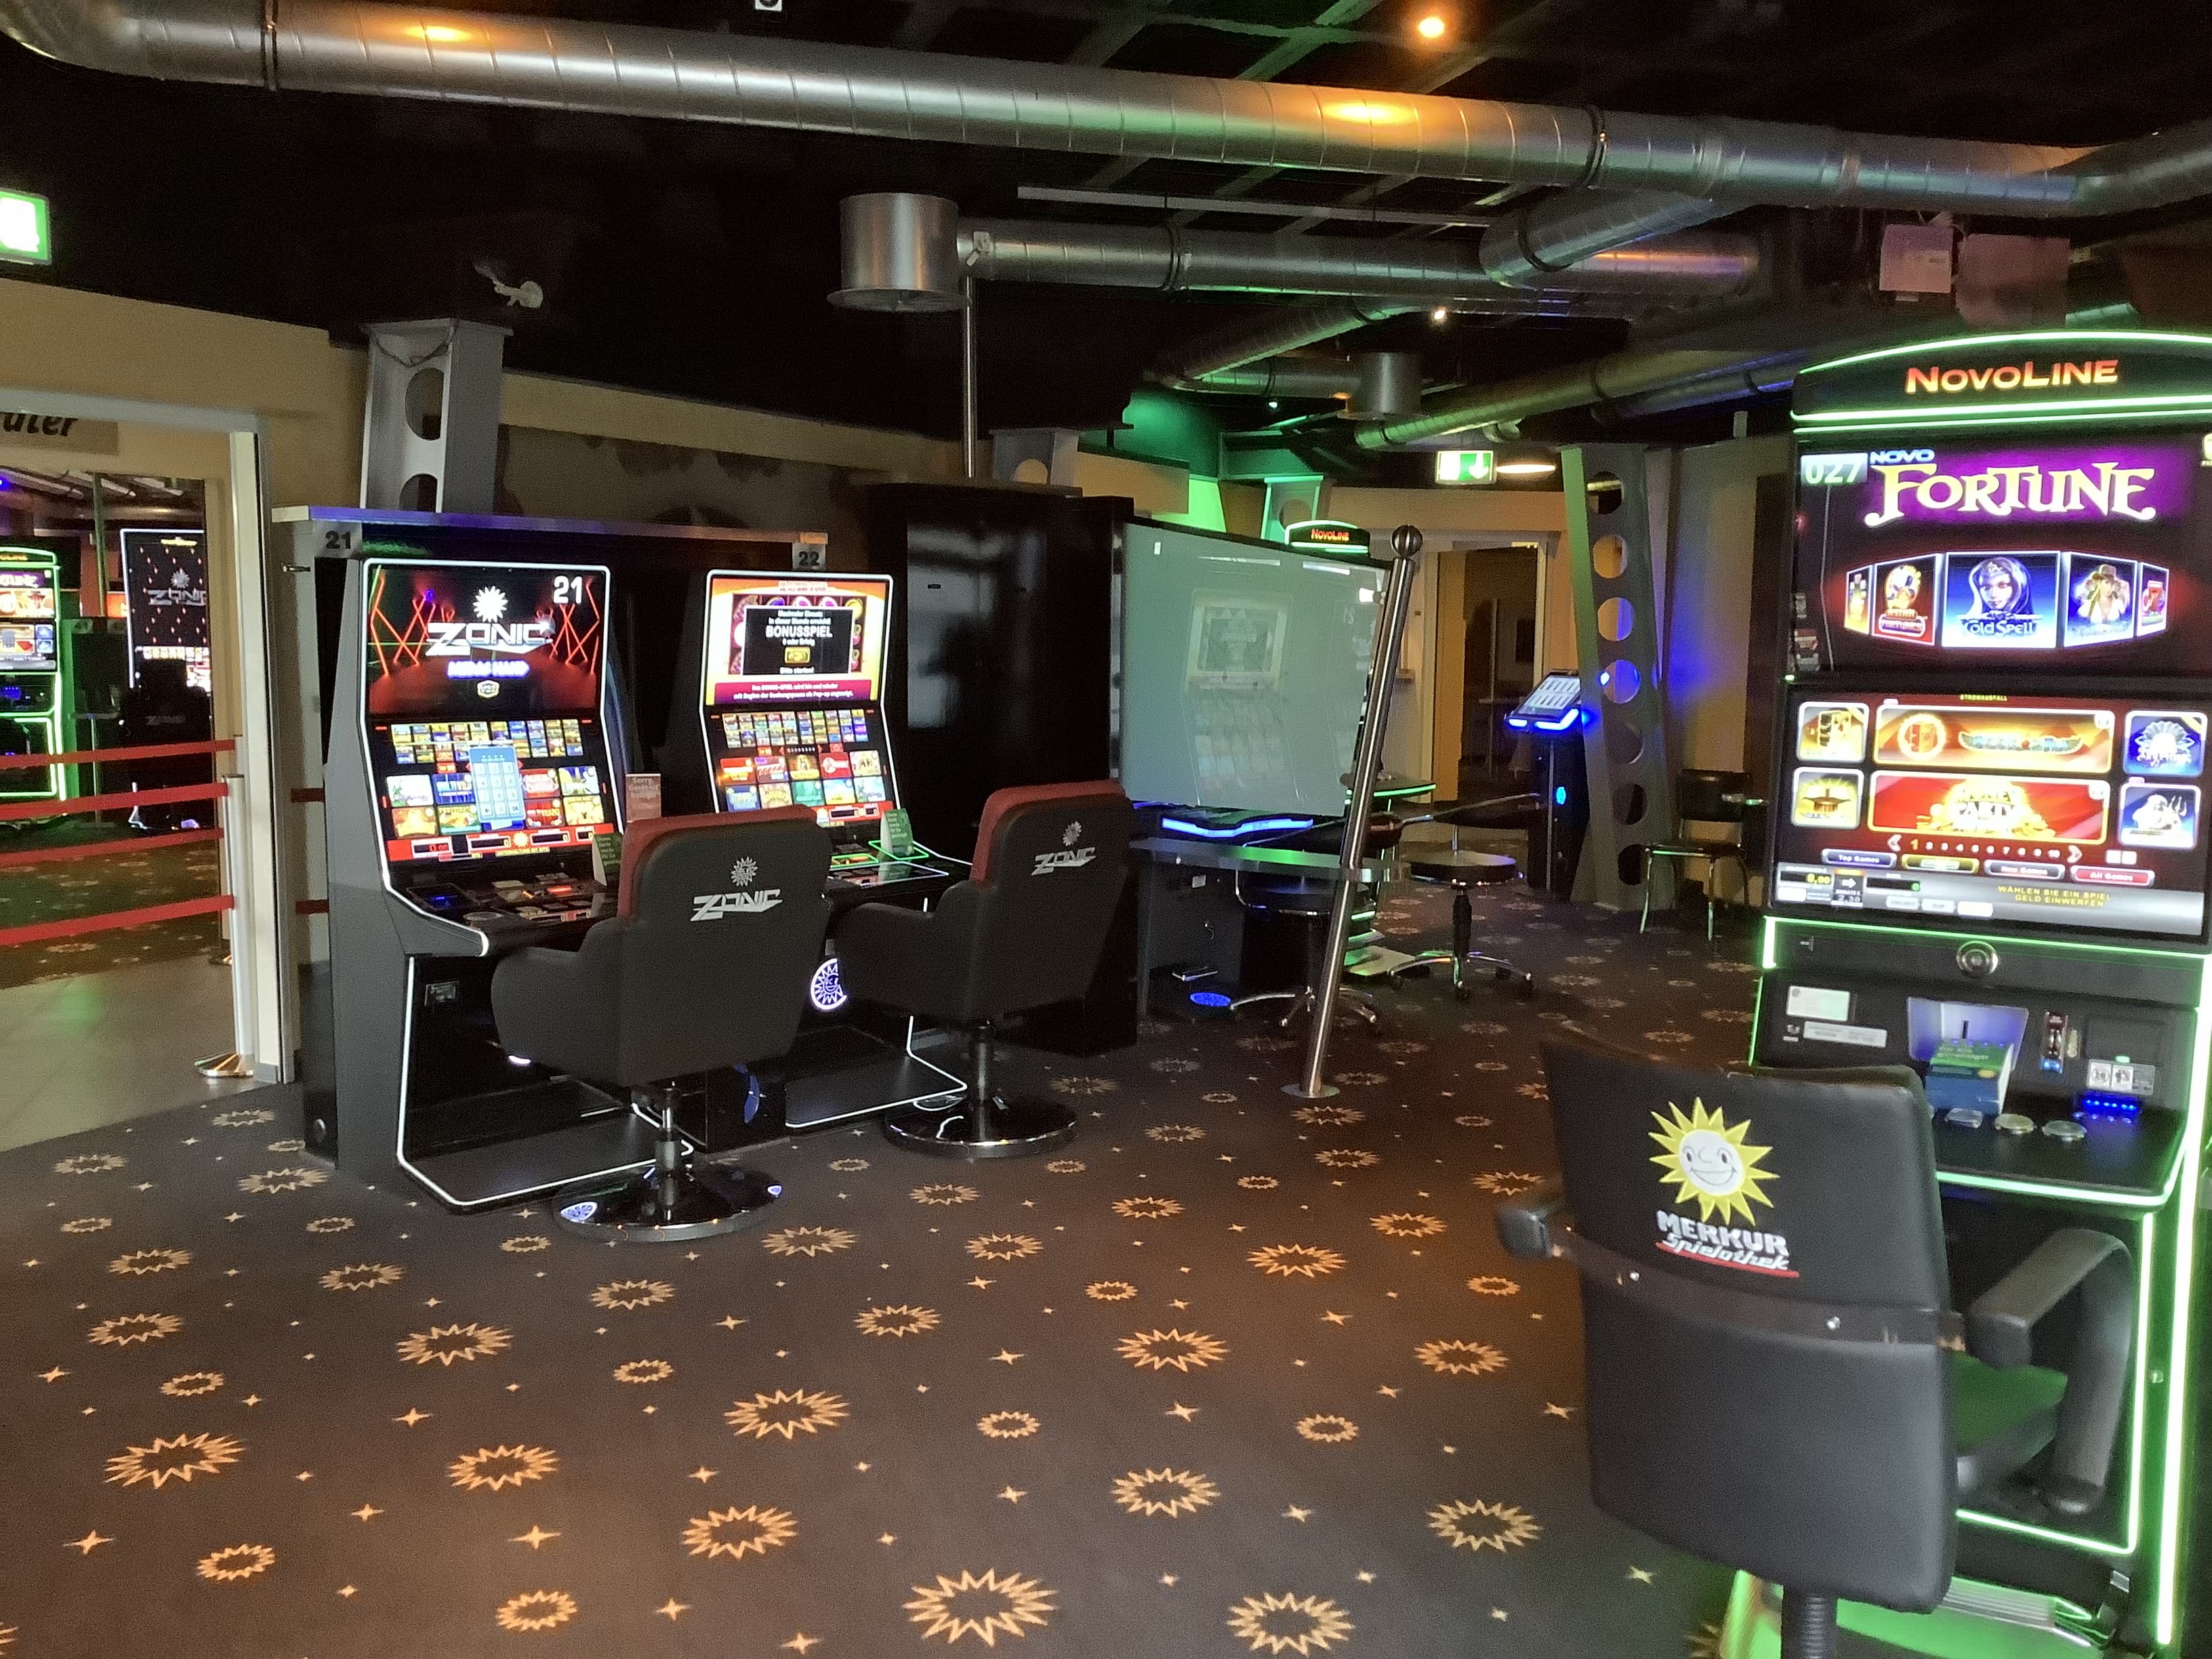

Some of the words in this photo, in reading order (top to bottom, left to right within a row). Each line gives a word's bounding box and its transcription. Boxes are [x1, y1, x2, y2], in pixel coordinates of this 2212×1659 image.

[1870, 449, 1935, 464] NOVO
[1803, 457, 1862, 485] 027
[1864, 462, 2156, 527] FORTUNE
[325, 530, 351, 550] 21
[799, 552, 820, 566] 22
[553, 576, 583, 605] 21
[426, 621, 554, 657] ZONIC
[766, 625, 833, 638] BONUSSPIEL
[1838, 854, 1853, 863] Top
[1910, 838, 1919, 851] 1
[690, 888, 783, 922] ZONIC
[1656, 1210, 1789, 1257] MERKUR
[1662, 1232, 1790, 1271] Spielothek
